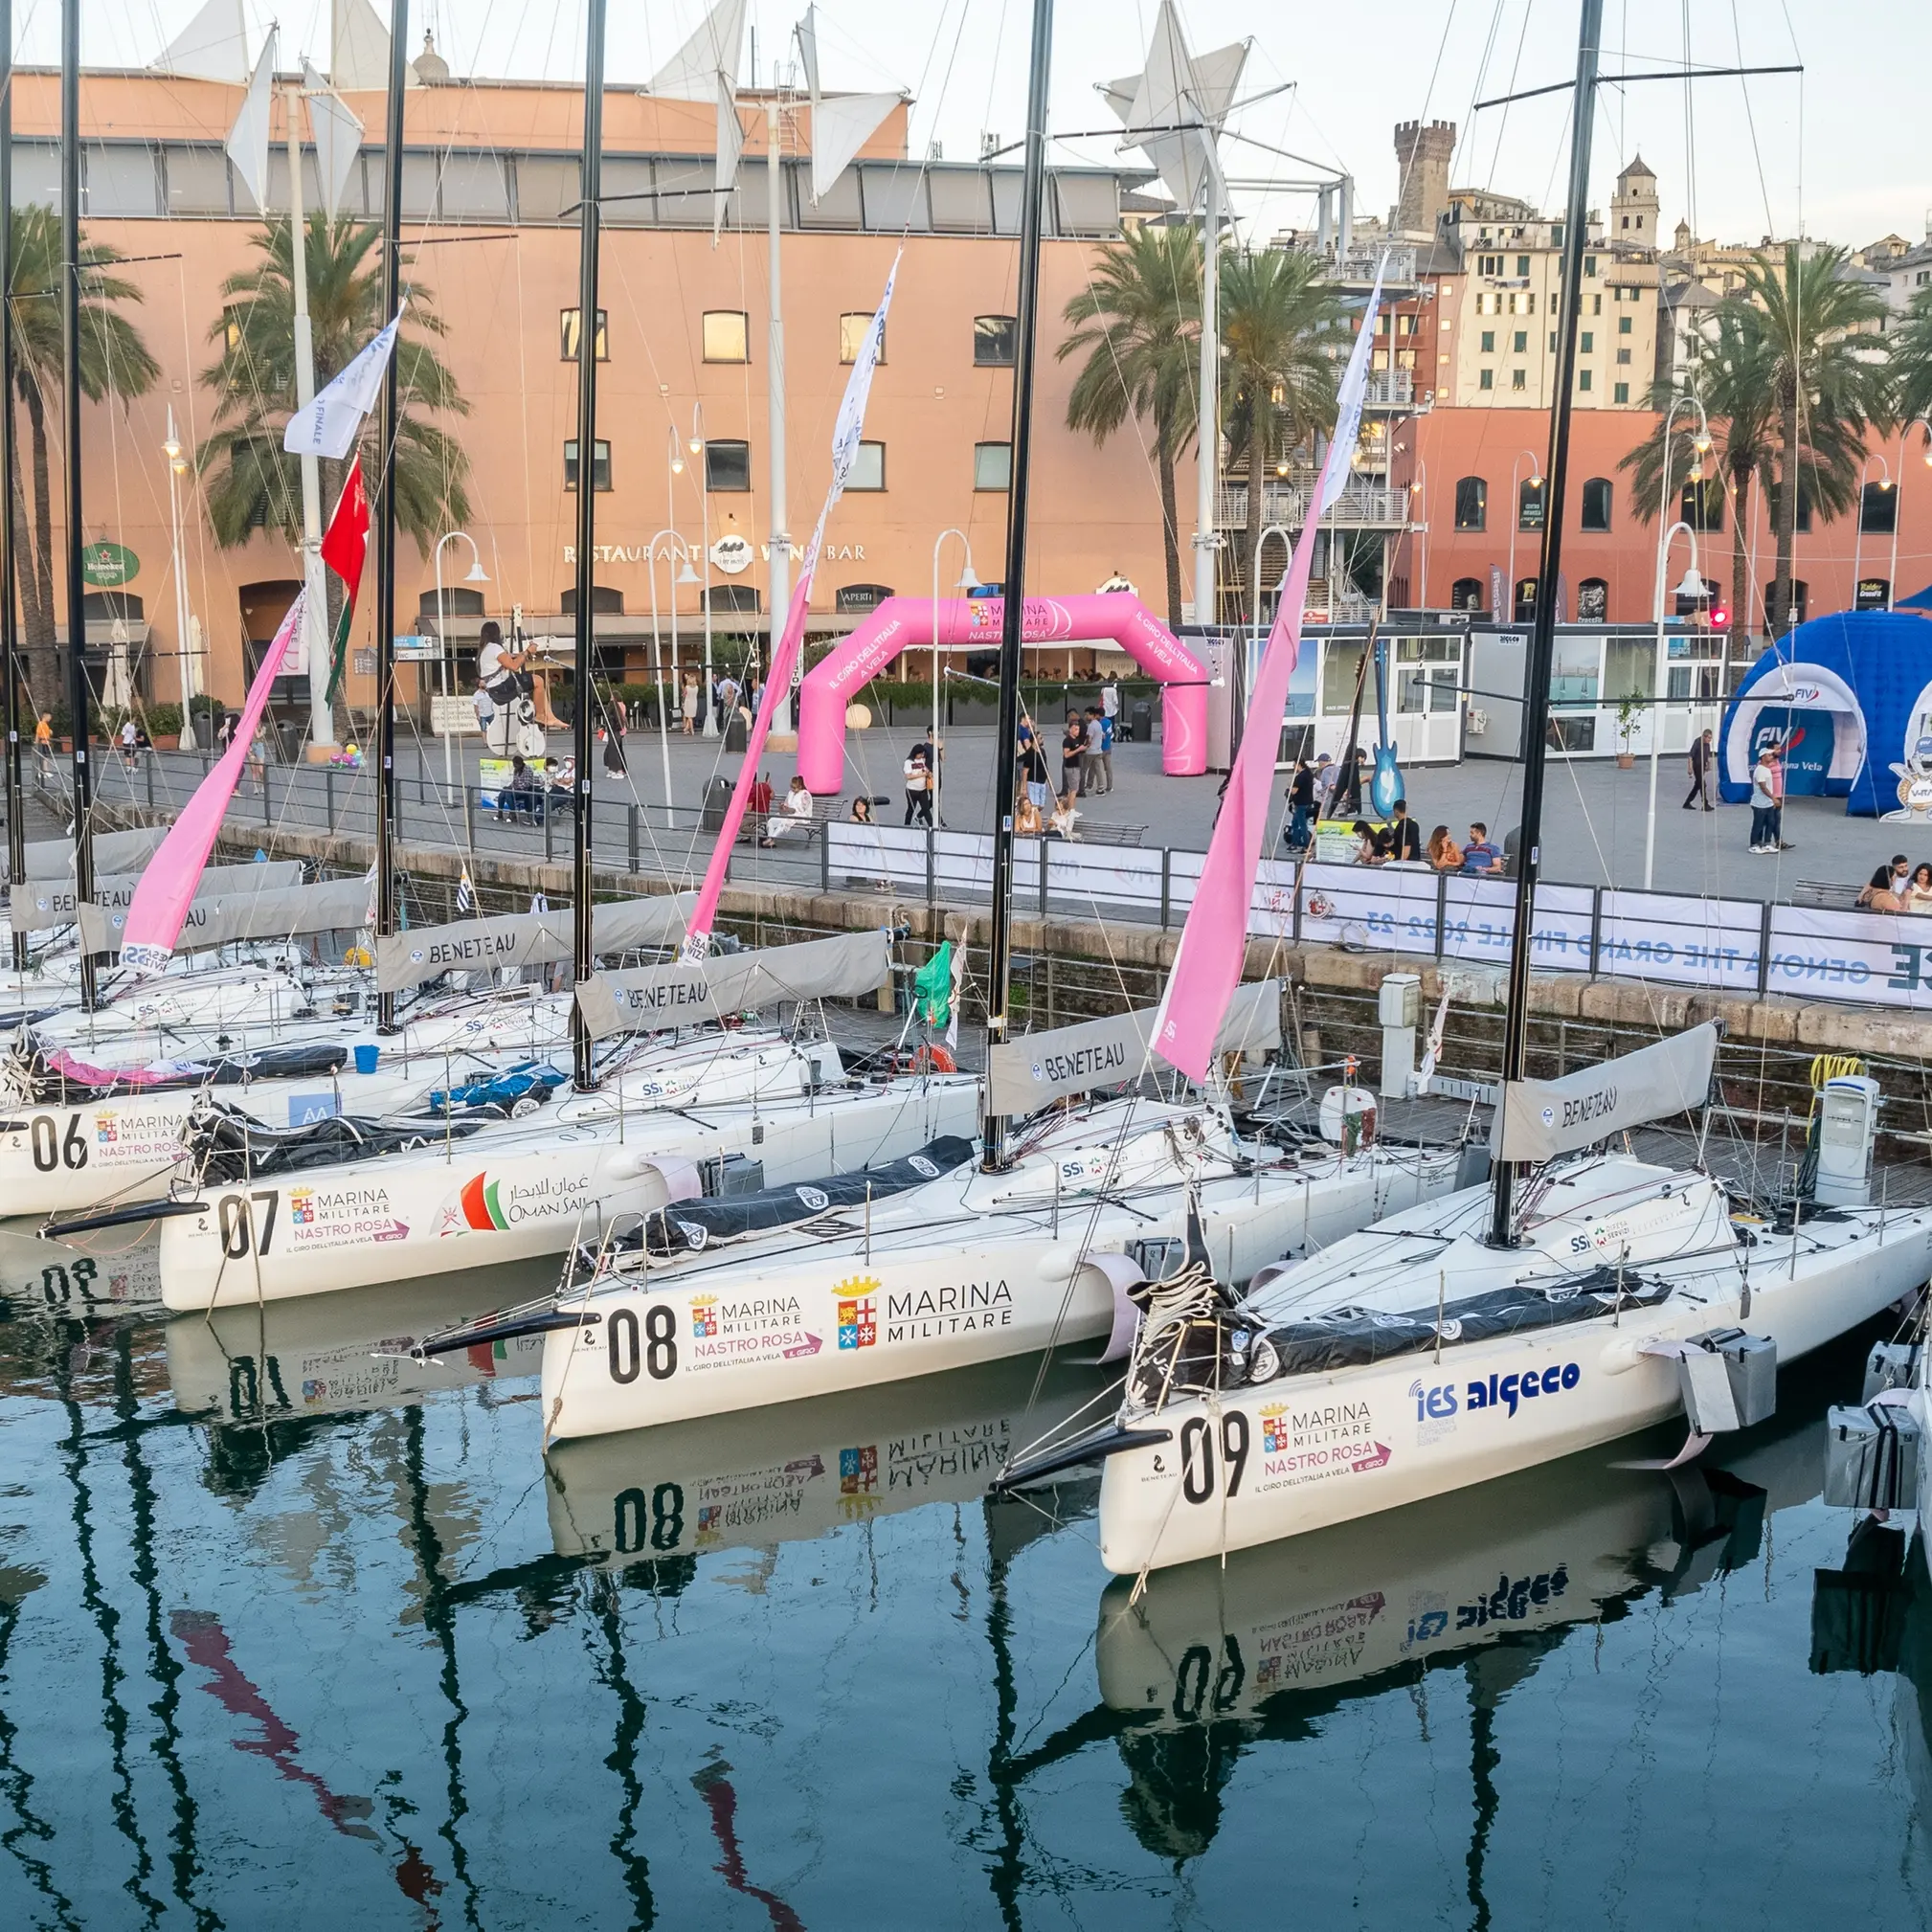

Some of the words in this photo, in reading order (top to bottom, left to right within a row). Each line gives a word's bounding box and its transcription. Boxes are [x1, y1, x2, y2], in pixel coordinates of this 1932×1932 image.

[313, 406, 325, 445] FINALE
[827, 545, 865, 561] BAR
[829, 680, 839, 689] IL
[837, 661, 858, 683] GIRO
[857, 619, 901, 663] DELL'ITALIA
[1136, 611, 1143, 621] IL
[1143, 618, 1161, 638] GIRO
[1160, 635, 1198, 675] DELL'ITALIA
[1146, 640, 1154, 650] A
[1153, 647, 1172, 667] VELA
[861, 670, 868, 678] A
[866, 650, 888, 670] VELA
[1795, 689, 1813, 698] FIV
[1755, 727, 1792, 750] FIV
[1802, 762, 1823, 771] Vela
[429, 933, 515, 964] BENETEAU
[627, 981, 708, 1009] BENETEAU
[1045, 1042, 1125, 1081] BENETEAU
[642, 1082, 663, 1097] SSi
[1562, 1086, 1617, 1128] BENETEAU
[31, 1113, 88, 1172] 06
[100, 1143, 151, 1157] NASTRO
[156, 1141, 180, 1152] ROS
[1062, 1162, 1084, 1178] SSi
[318, 1188, 389, 1209] MARINA
[218, 1190, 279, 1259] 07
[319, 1204, 391, 1220] MILITARE
[294, 1223, 351, 1242] NASTRO
[354, 1218, 393, 1235] ROSA
[311, 1240, 348, 1250] DELL'ITALIA
[355, 1236, 372, 1244] VELA
[384, 1232, 404, 1240] GIRO
[1571, 1236, 1591, 1252] SSi
[721, 1296, 800, 1320] MARINA
[888, 1280, 1012, 1319] MARINA
[723, 1314, 801, 1334] MILITARE
[888, 1310, 1012, 1343] MILITARE
[607, 1304, 677, 1384] 08
[694, 1336, 759, 1358] NASTRO
[761, 1330, 803, 1348] ROSA
[796, 1347, 816, 1356] GIRO
[693, 1362, 712, 1371] GIRO
[713, 1357, 755, 1369] DELL'ITALIA
[762, 1352, 781, 1361] VELA
[1467, 1362, 1581, 1419] algeco
[1292, 1401, 1371, 1432] MARINA
[1293, 1422, 1372, 1448] MILITARE
[1180, 1410, 1250, 1505] 09
[1264, 1451, 1328, 1477] NASTRO
[1331, 1441, 1372, 1463] ROSA
[1365, 1460, 1384, 1469] GIRO
[1263, 1482, 1281, 1492] GIRO
[1282, 1473, 1324, 1488] DELL'ITALIA
[1331, 1467, 1350, 1476] VELA
